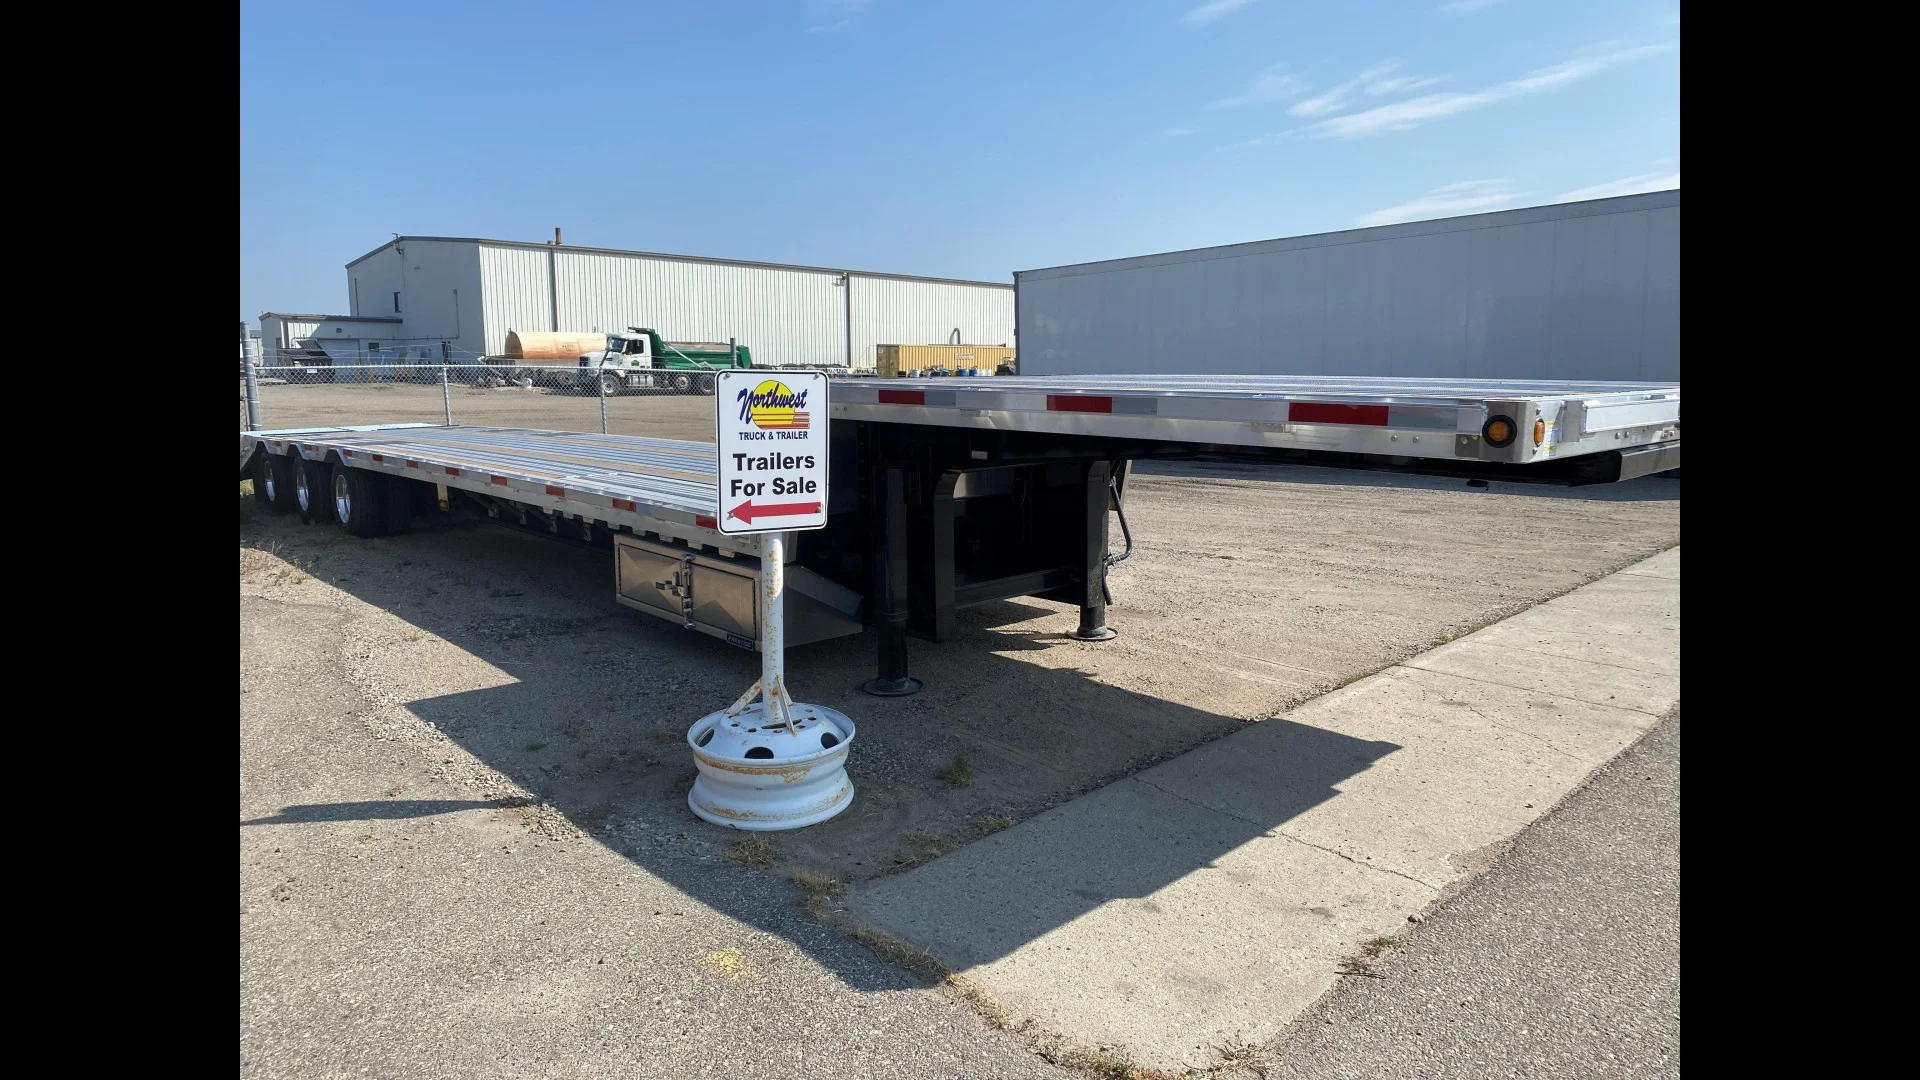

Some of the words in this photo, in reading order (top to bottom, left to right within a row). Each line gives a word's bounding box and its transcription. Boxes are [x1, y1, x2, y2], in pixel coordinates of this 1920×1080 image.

[737, 383, 808, 425] Northwest
[739, 432, 766, 441] TRUCK
[768, 431, 774, 440] &
[776, 431, 808, 440] TRAILER
[732, 452, 815, 471] Trailers
[731, 479, 766, 497] For
[772, 476, 817, 495] Sale
